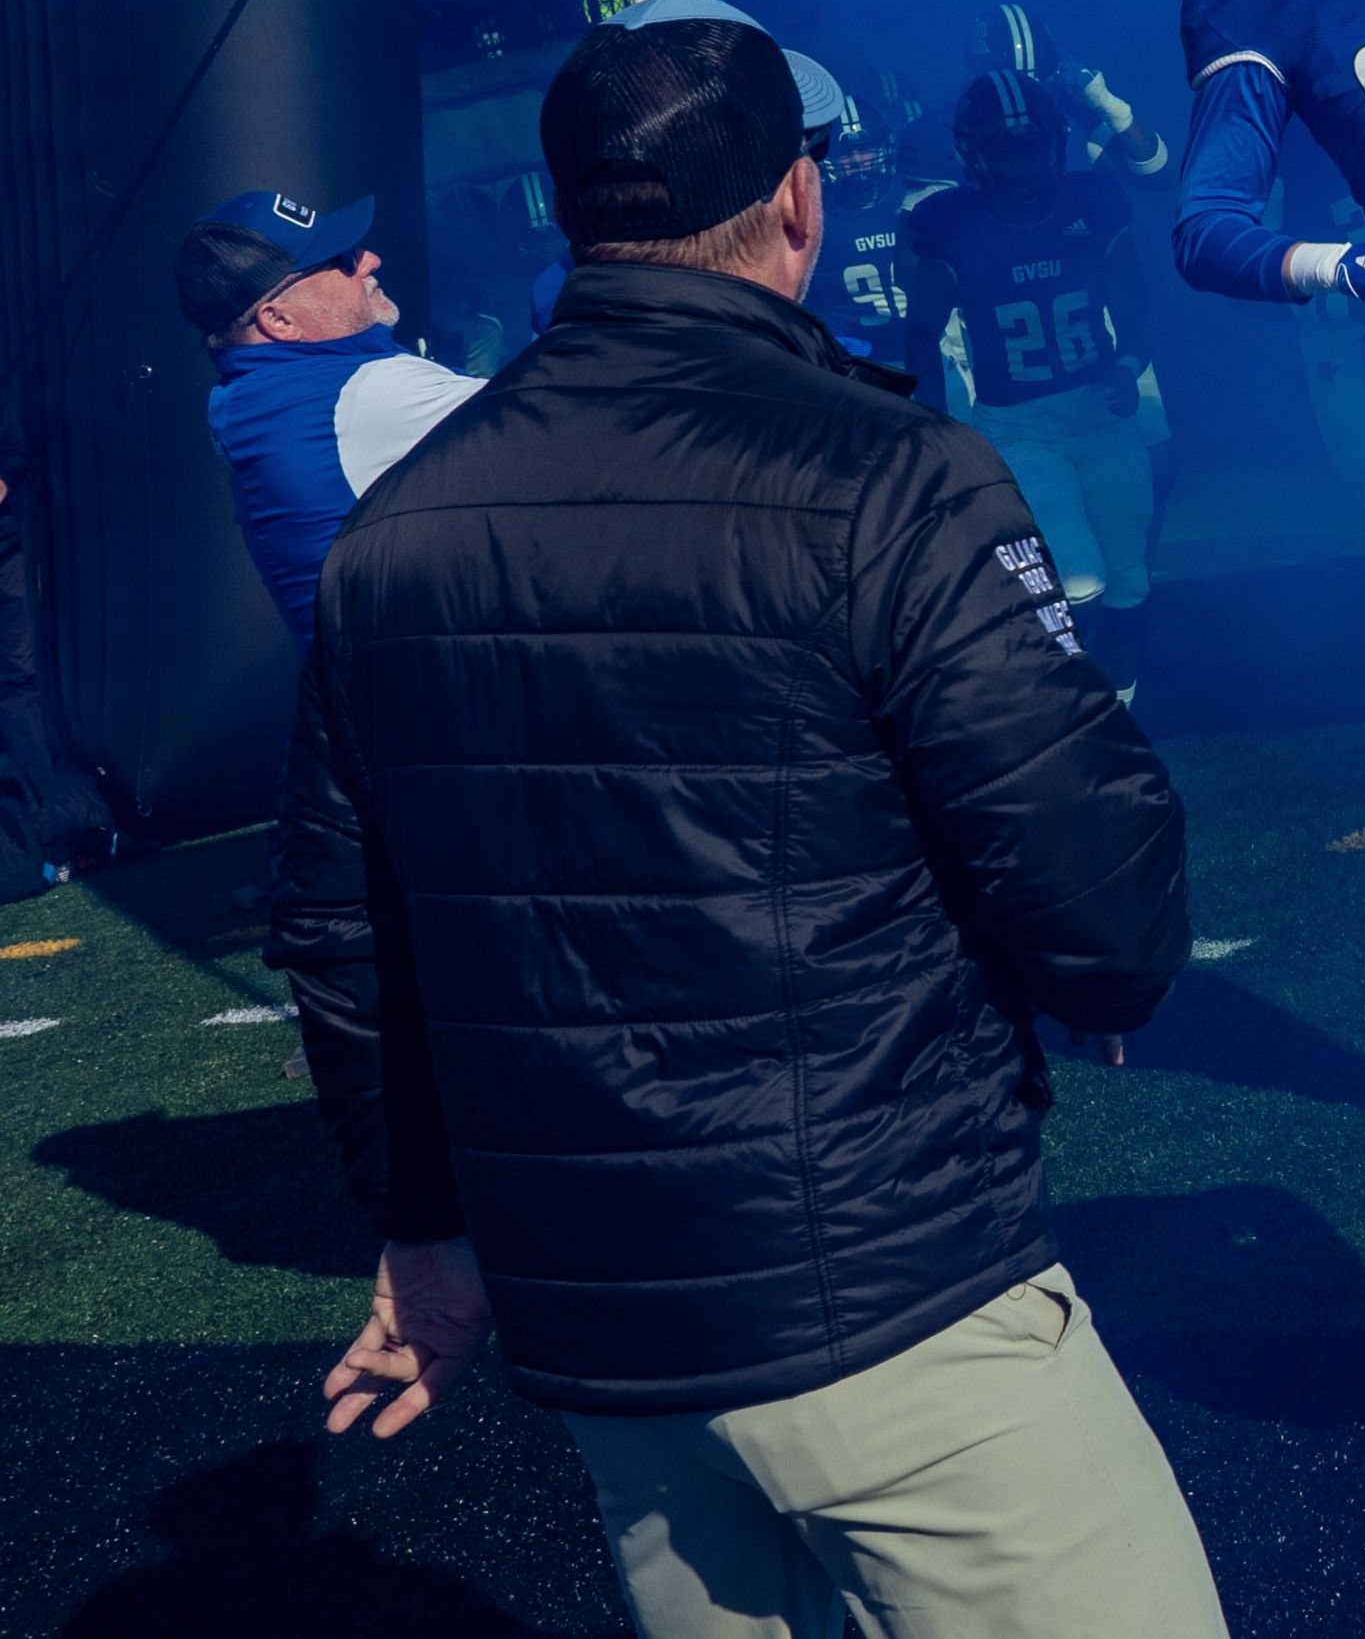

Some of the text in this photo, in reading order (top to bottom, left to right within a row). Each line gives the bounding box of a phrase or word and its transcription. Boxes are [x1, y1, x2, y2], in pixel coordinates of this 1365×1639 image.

[855, 233, 896, 252] GVSU
[1012, 260, 1061, 283] GVSU
[994, 289, 1098, 381] 26
